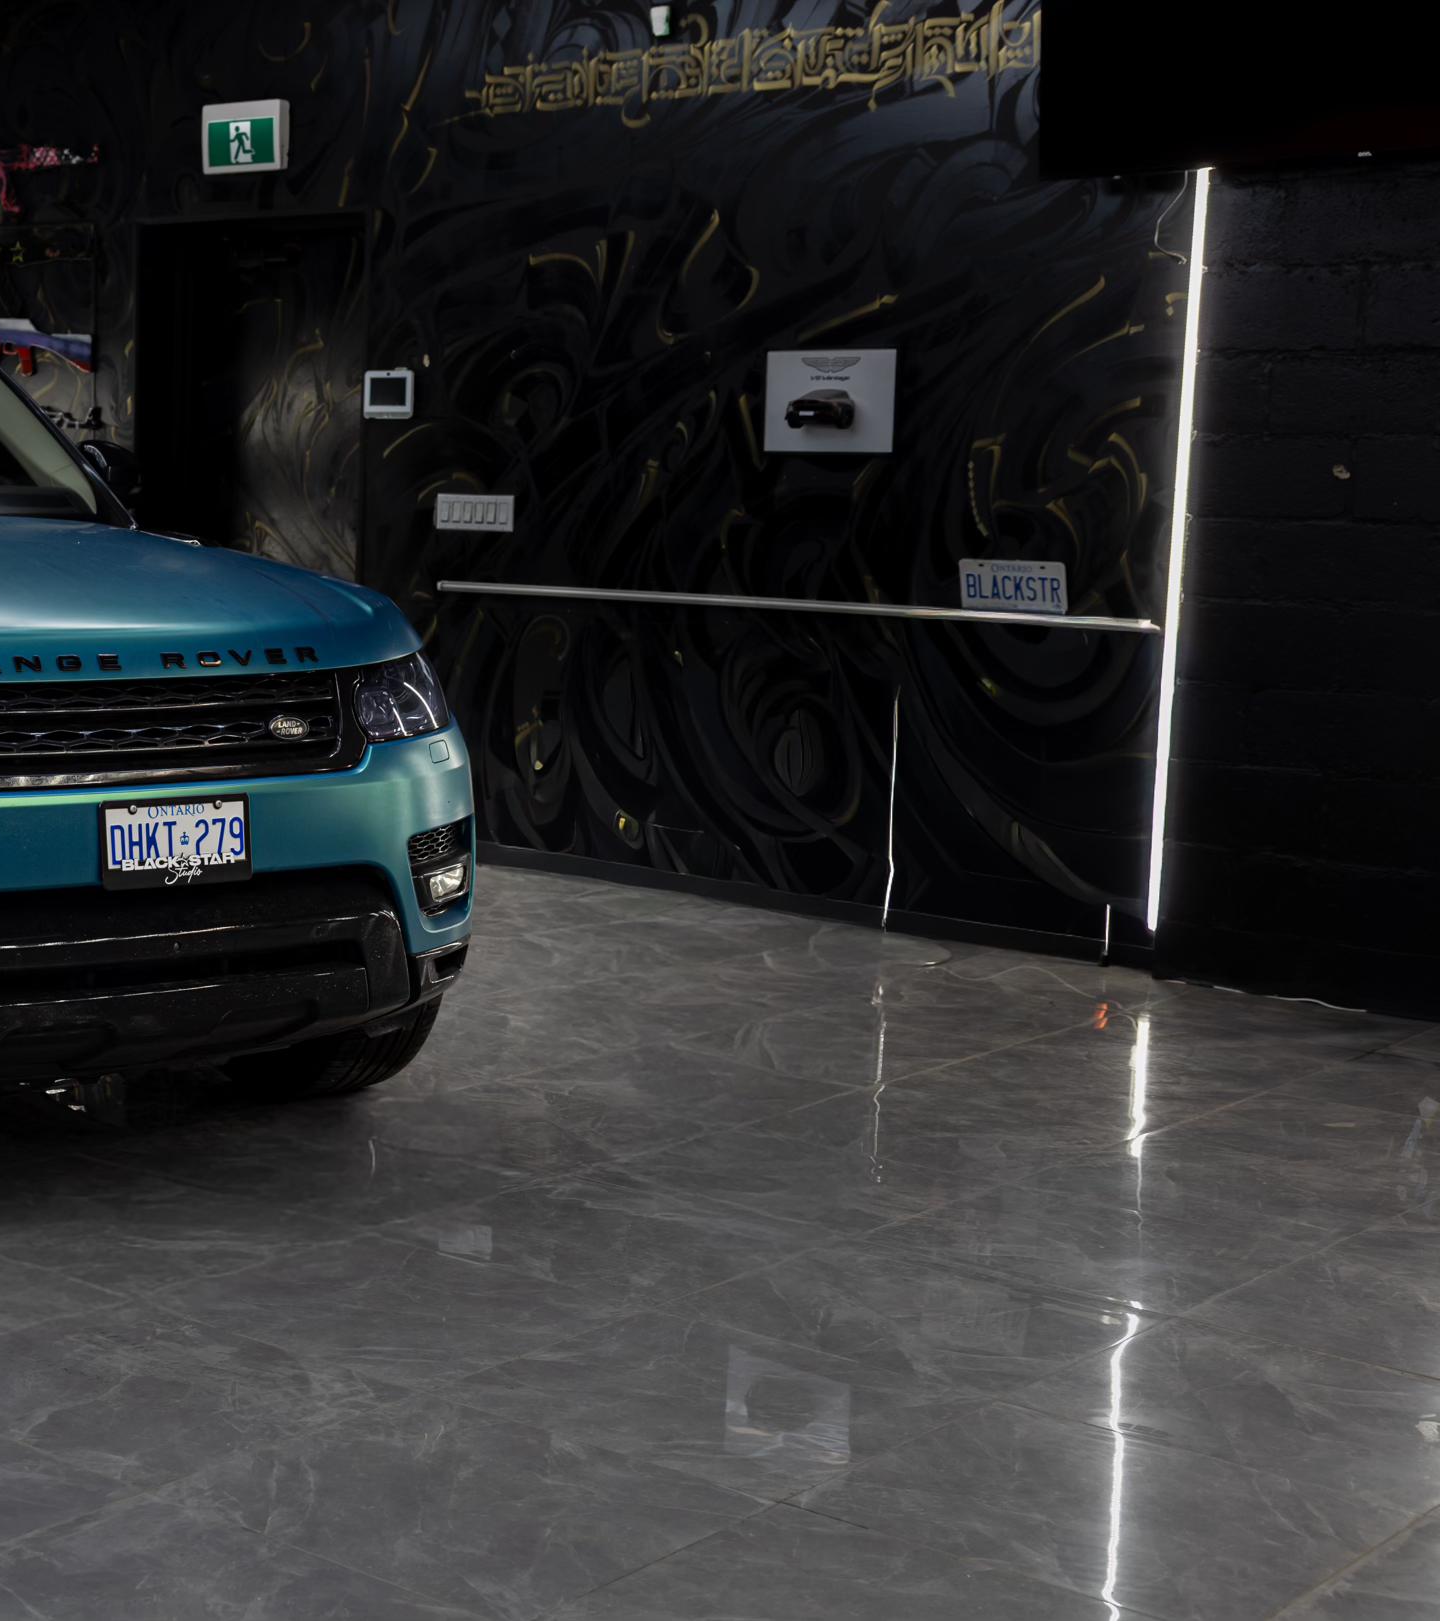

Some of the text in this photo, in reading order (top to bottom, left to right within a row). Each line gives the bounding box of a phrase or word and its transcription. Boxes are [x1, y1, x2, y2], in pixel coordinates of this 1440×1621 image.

[966, 573, 1062, 603] BLACKSTR
[160, 646, 319, 670] ROVER
[147, 803, 205, 819] ONTARIO
[110, 816, 245, 867] DHKT 279
[121, 852, 236, 872] BLACK STAR
[164, 865, 203, 885] Studio
